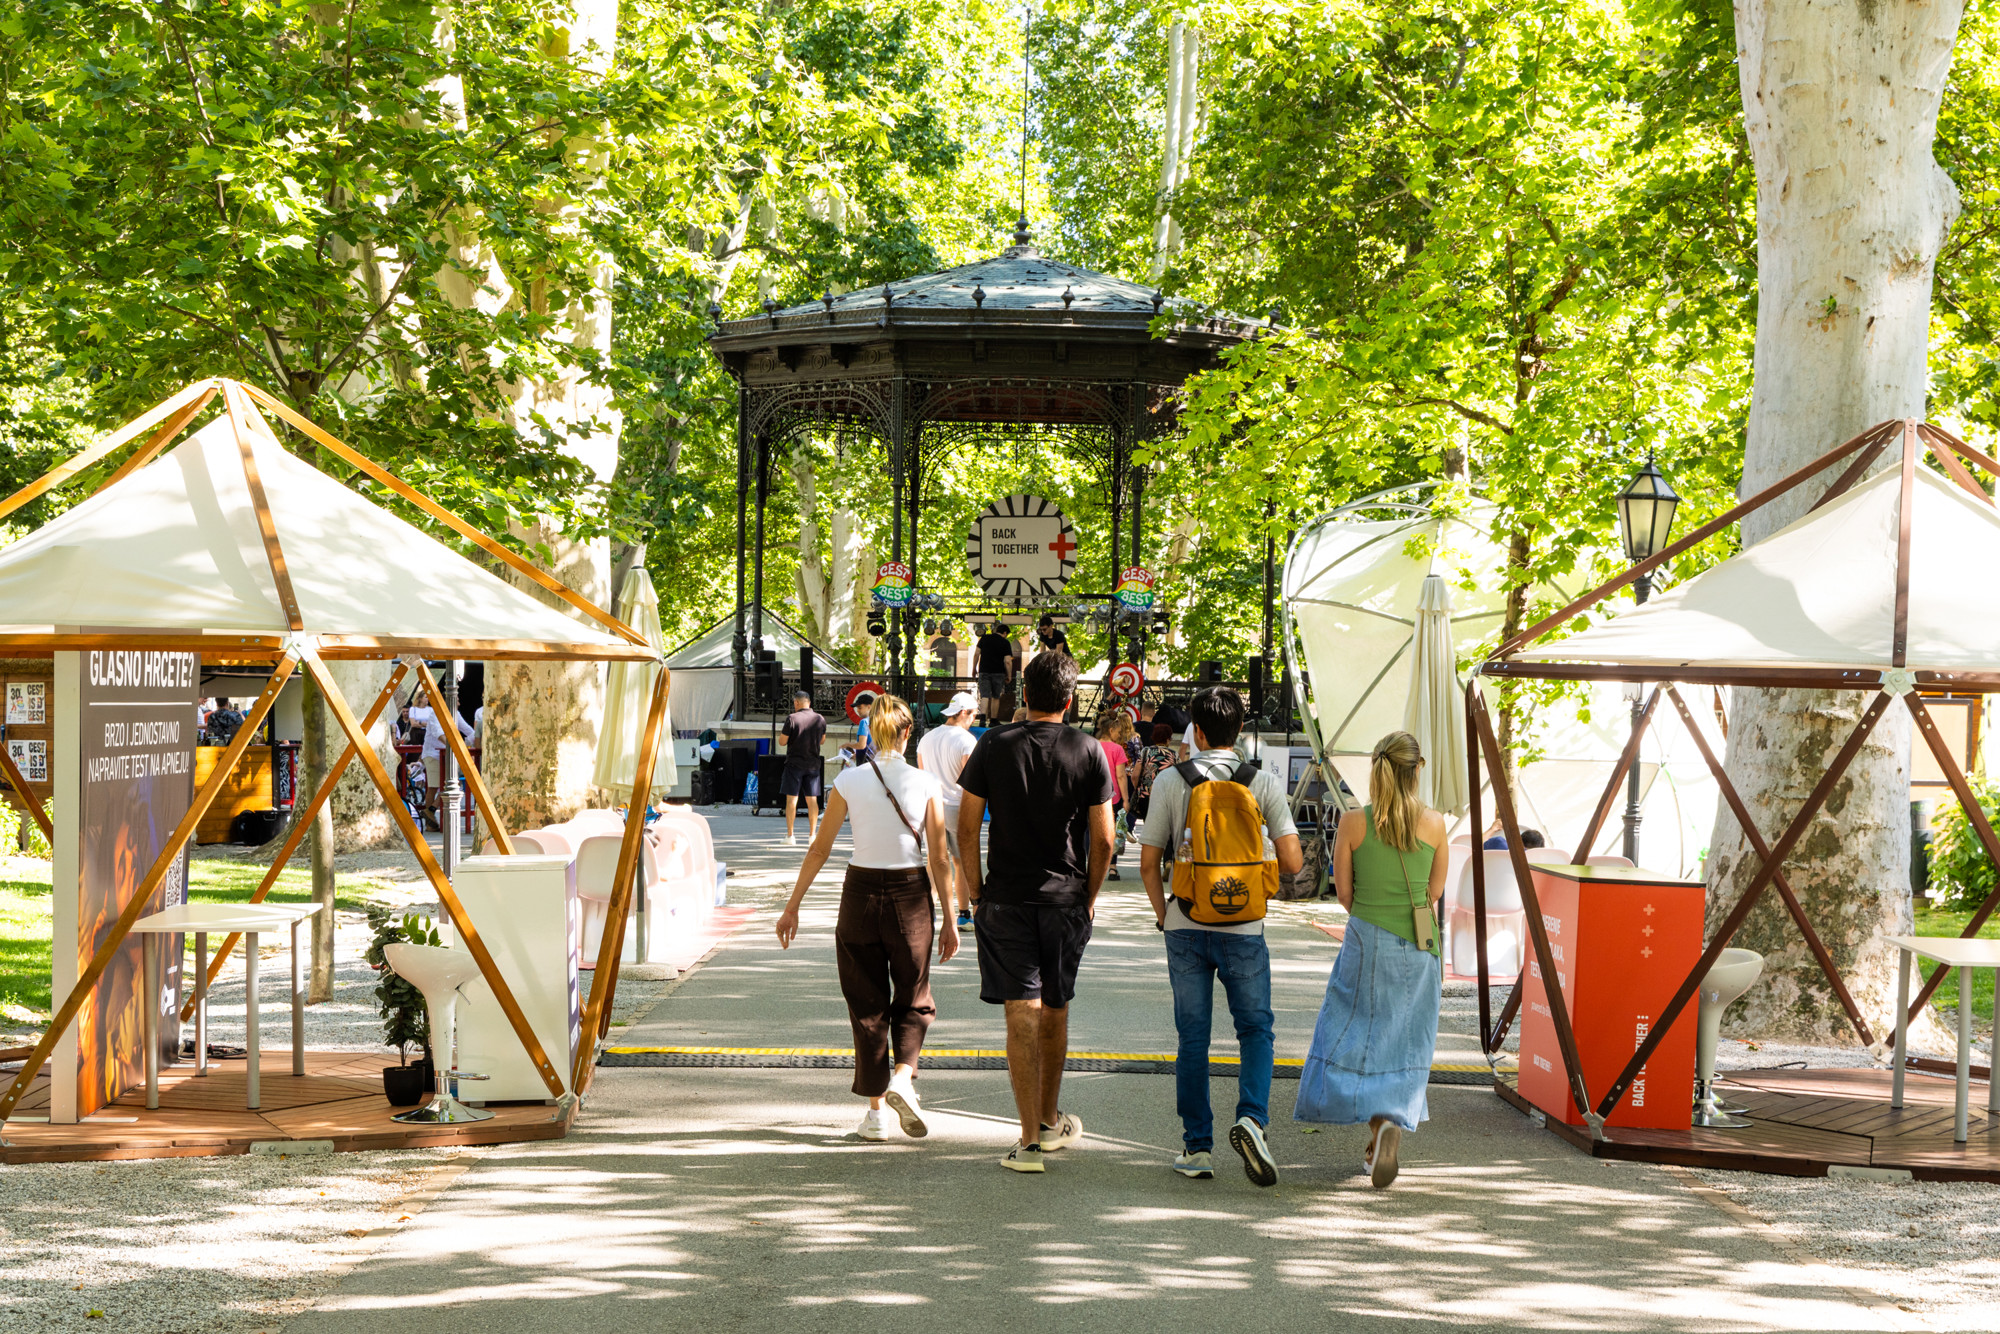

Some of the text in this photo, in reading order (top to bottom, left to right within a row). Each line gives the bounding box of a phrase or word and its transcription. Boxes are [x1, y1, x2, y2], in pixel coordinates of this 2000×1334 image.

[992, 528, 1016, 539] BACK
[992, 544, 1039, 555] TOGETHER
[879, 563, 910, 578] CEST
[1121, 568, 1152, 583] CEST
[879, 585, 910, 600] BEST
[1120, 590, 1152, 605] BEST
[90, 650, 142, 687] GLASNO
[27, 684, 44, 696] CEST
[28, 710, 44, 721] BEST
[104, 720, 180, 747] BRZO I JEDNOSTAVNO
[29, 742, 45, 753] CEST
[30, 768, 45, 779] BEST
[88, 751, 190, 783] NAPRAVITE TEST NA APNEJU!
[1632, 1079, 1646, 1107] BACK
